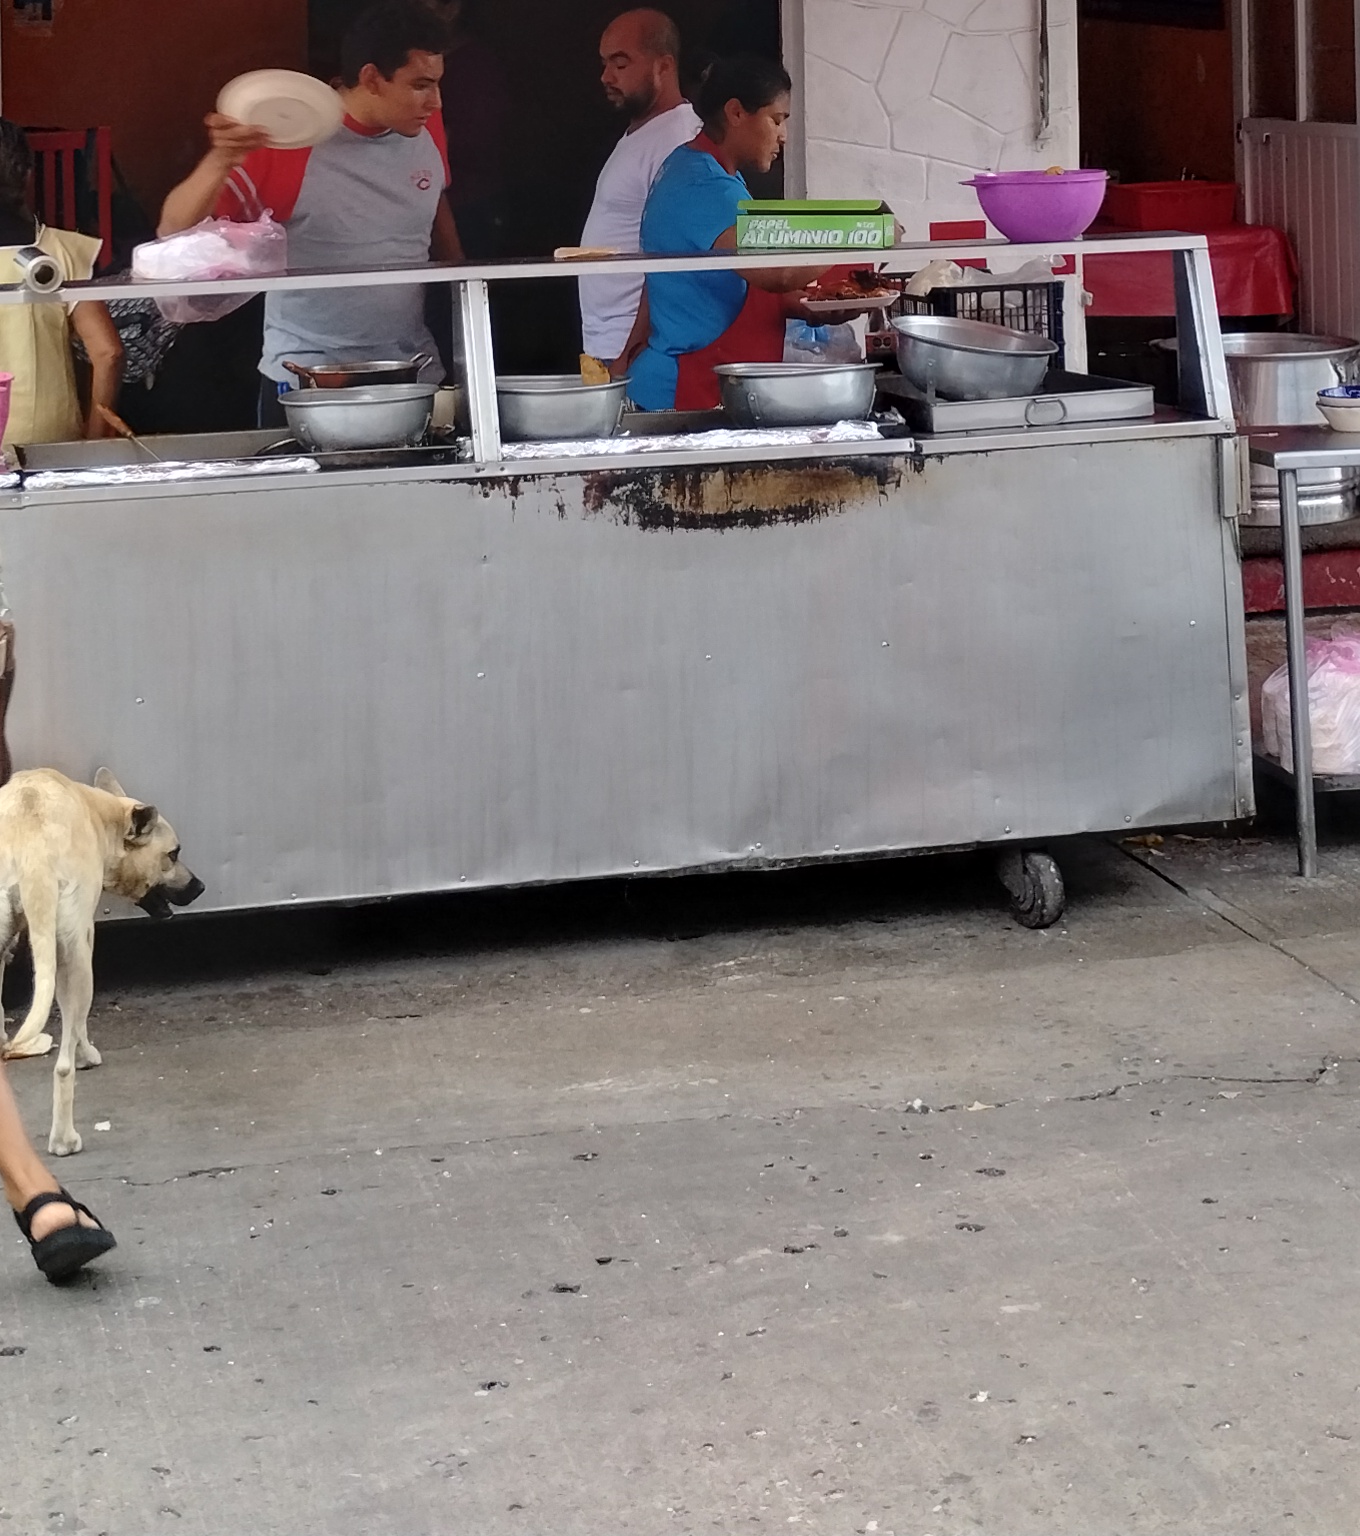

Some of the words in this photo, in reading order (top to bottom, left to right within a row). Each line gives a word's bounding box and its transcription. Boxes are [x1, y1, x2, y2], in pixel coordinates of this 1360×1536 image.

[748, 220, 790, 230] PAPEL
[741, 230, 843, 245] ALUMINIO
[847, 230, 882, 245] 100
